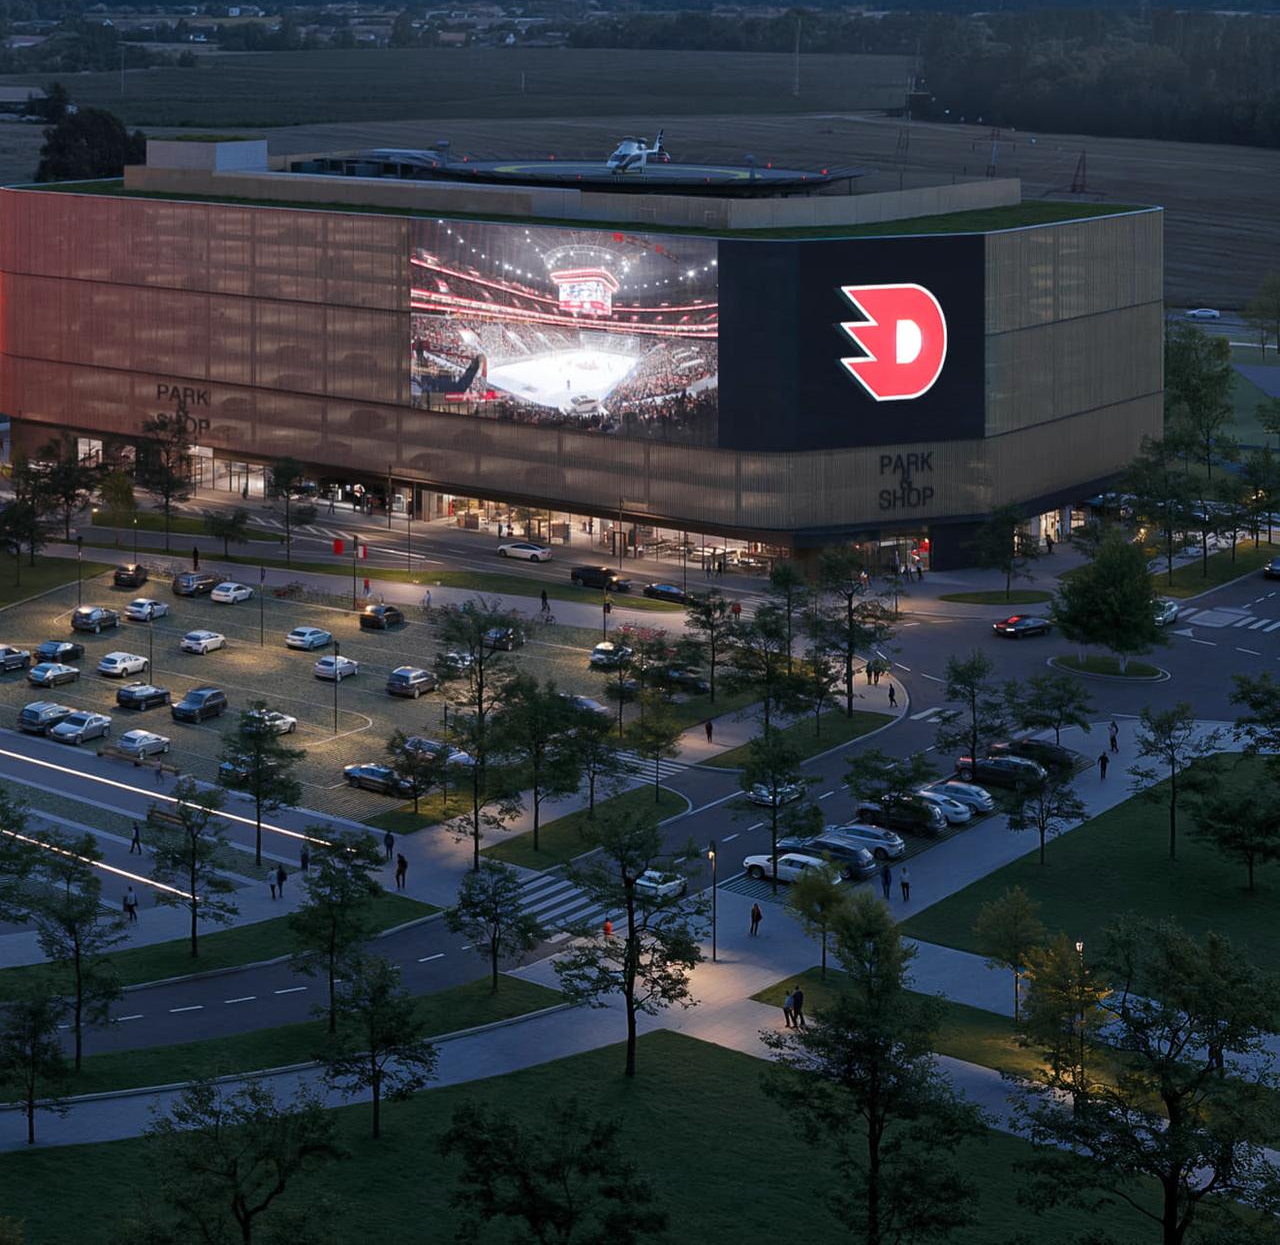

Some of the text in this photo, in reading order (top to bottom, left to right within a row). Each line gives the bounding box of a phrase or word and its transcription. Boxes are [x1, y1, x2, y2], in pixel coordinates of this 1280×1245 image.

[840, 283, 948, 402] D
[157, 384, 210, 406] PARK
[880, 451, 935, 475] PARK
[879, 486, 935, 511] SHOP
